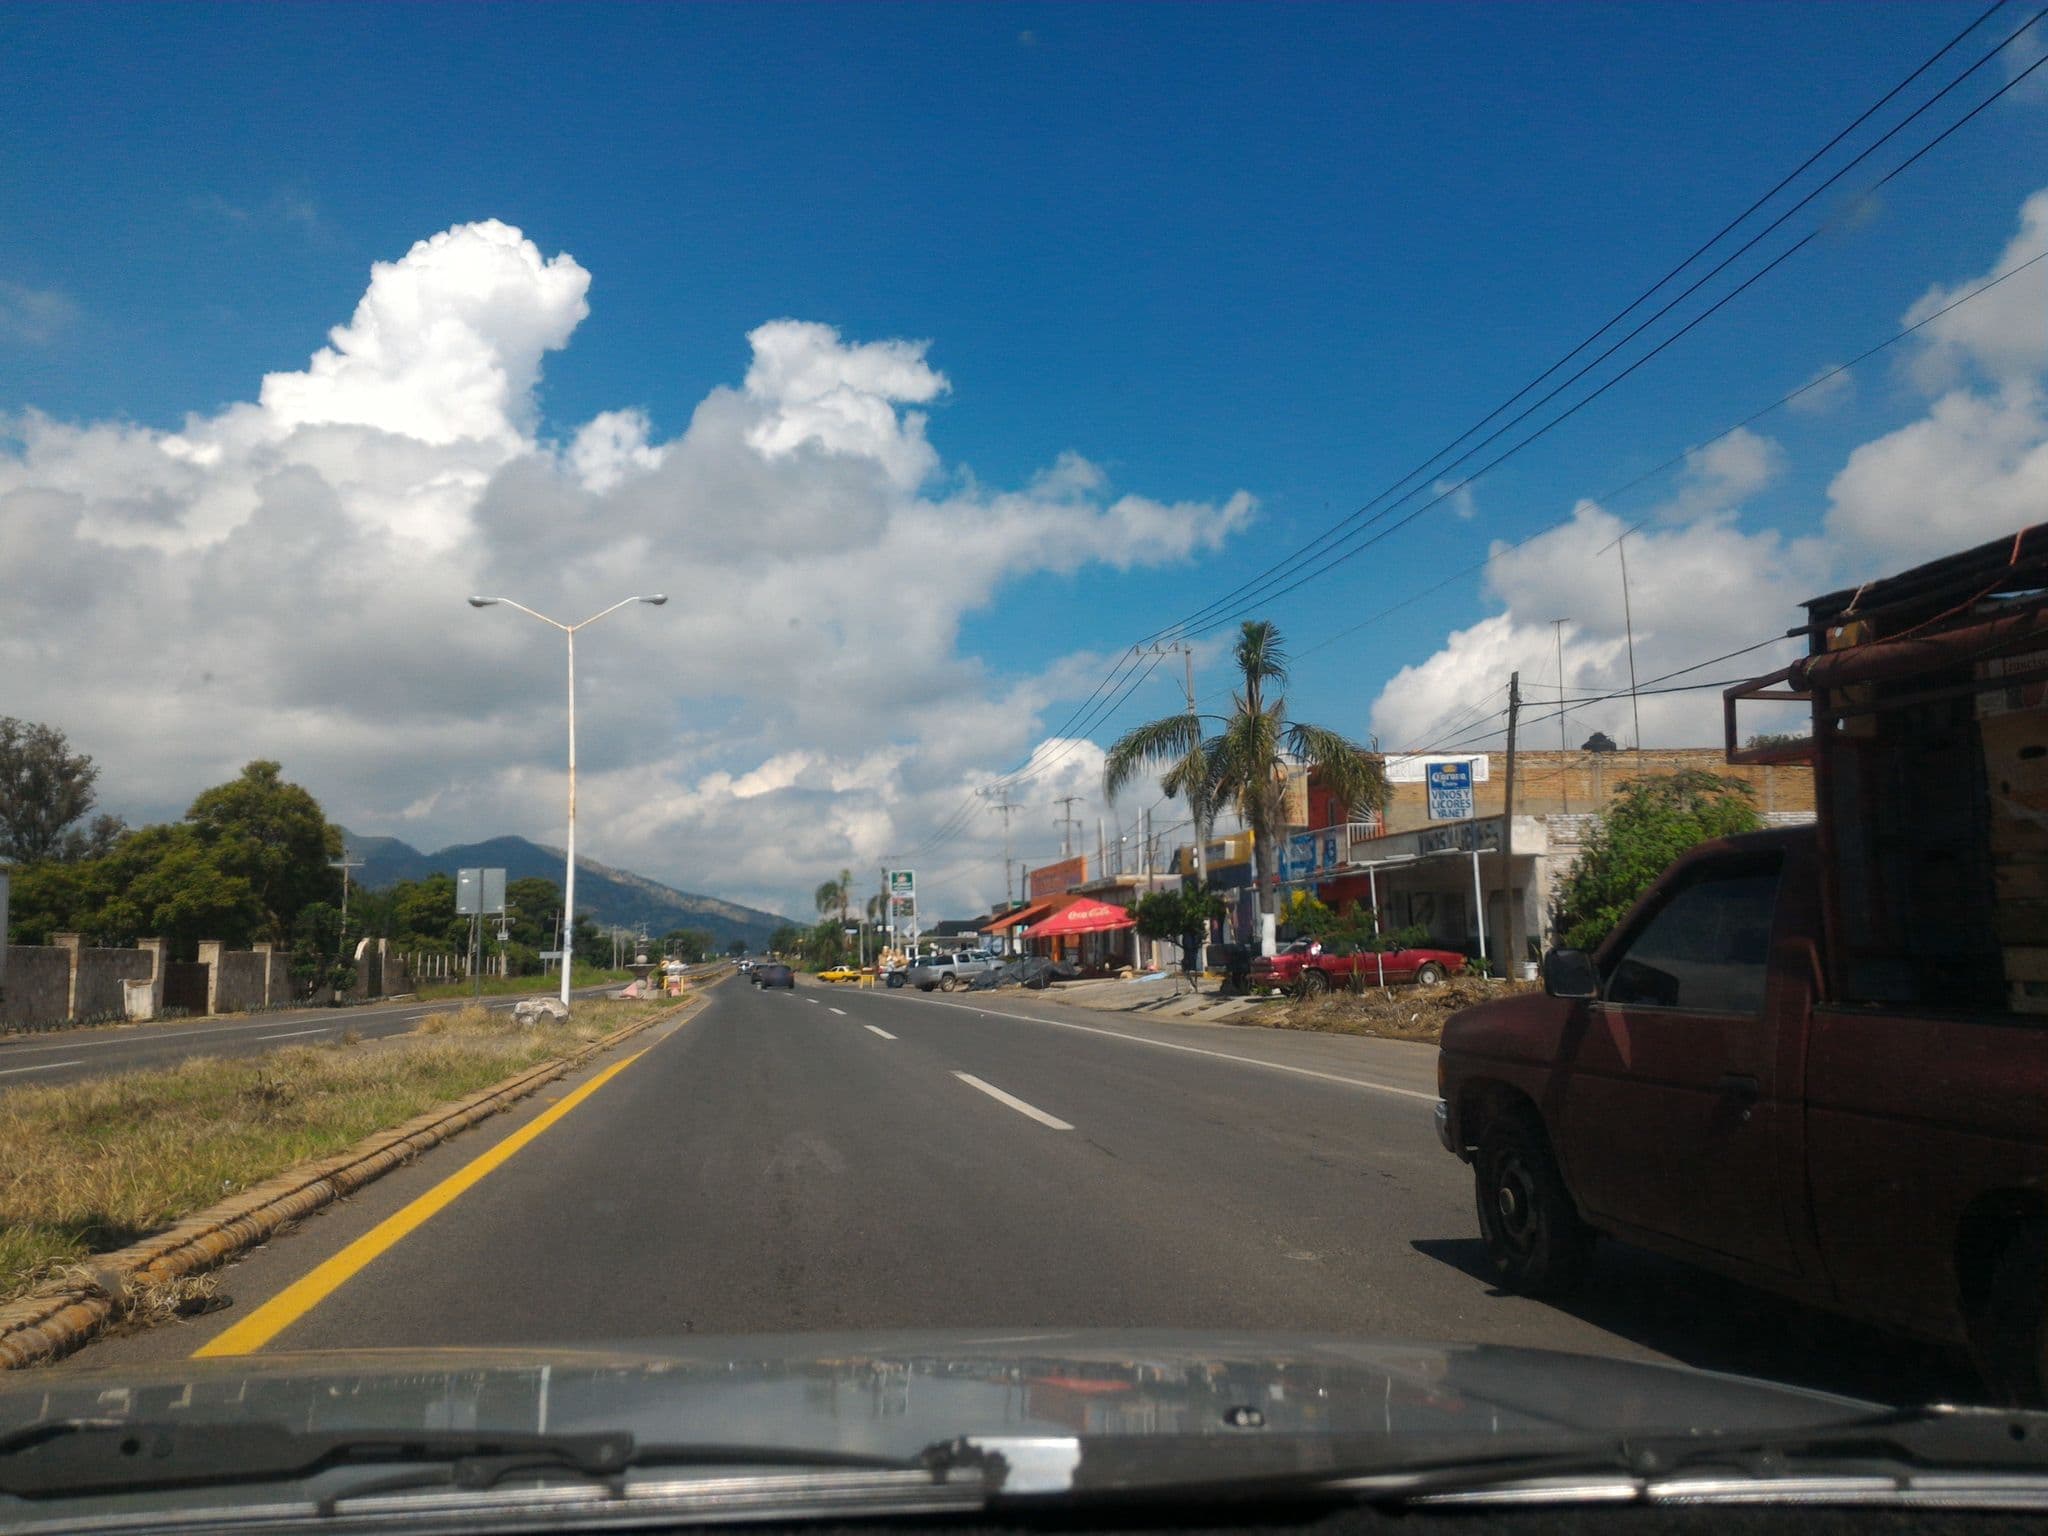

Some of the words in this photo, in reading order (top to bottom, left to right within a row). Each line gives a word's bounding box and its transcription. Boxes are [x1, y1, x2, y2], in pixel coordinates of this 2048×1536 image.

[1432, 772, 1466, 782] Corona
[1432, 791, 1462, 799] VINOS
[1432, 799, 1471, 809] LICORES
